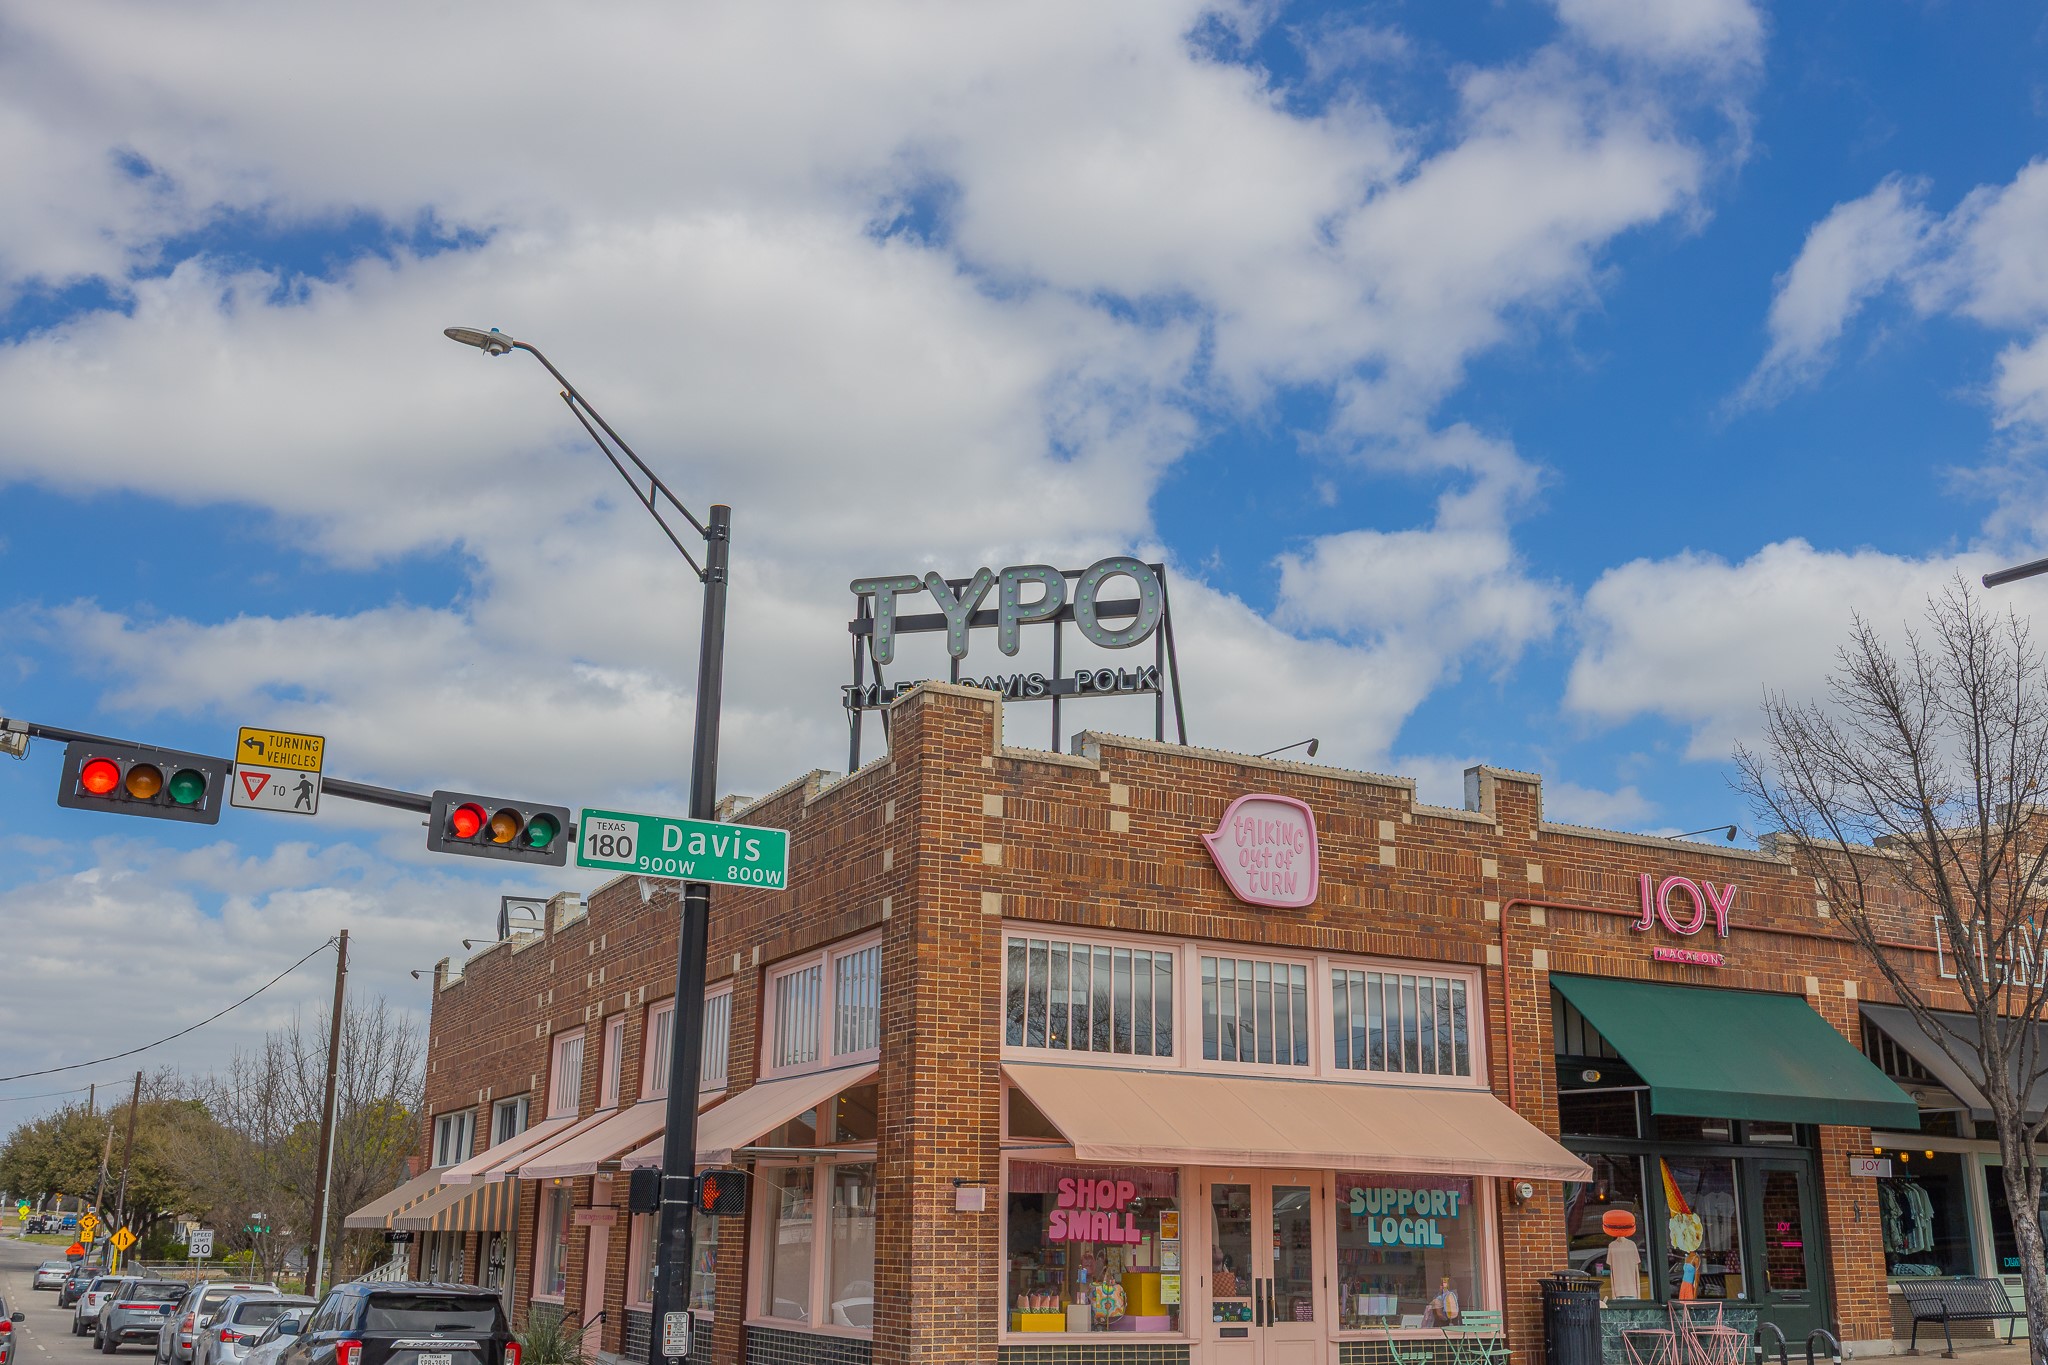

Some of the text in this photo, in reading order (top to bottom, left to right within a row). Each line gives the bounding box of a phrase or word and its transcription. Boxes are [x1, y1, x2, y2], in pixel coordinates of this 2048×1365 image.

[850, 556, 1162, 665] TYPO
[1074, 665, 1160, 695] POLK
[269, 735, 319, 752] TURNING
[267, 751, 316, 767] VEHICLES
[272, 785, 286, 797] TO
[597, 821, 626, 832] TEXAS
[588, 833, 633, 858] 180
[662, 824, 761, 862] Davis
[639, 855, 782, 885] 900W 800W
[1632, 873, 1737, 939] JOY
[1657, 948, 1725, 966] MACARONS
[1861, 1160, 1880, 1171] JOY
[1058, 1177, 1138, 1211] SHOP
[1349, 1187, 1461, 1219] SUPPORT
[1049, 1210, 1142, 1244] SMALL
[1368, 1217, 1444, 1248] LOCAL
[1777, 1222, 1790, 1231] JOY
[192, 1244, 211, 1254] 30
